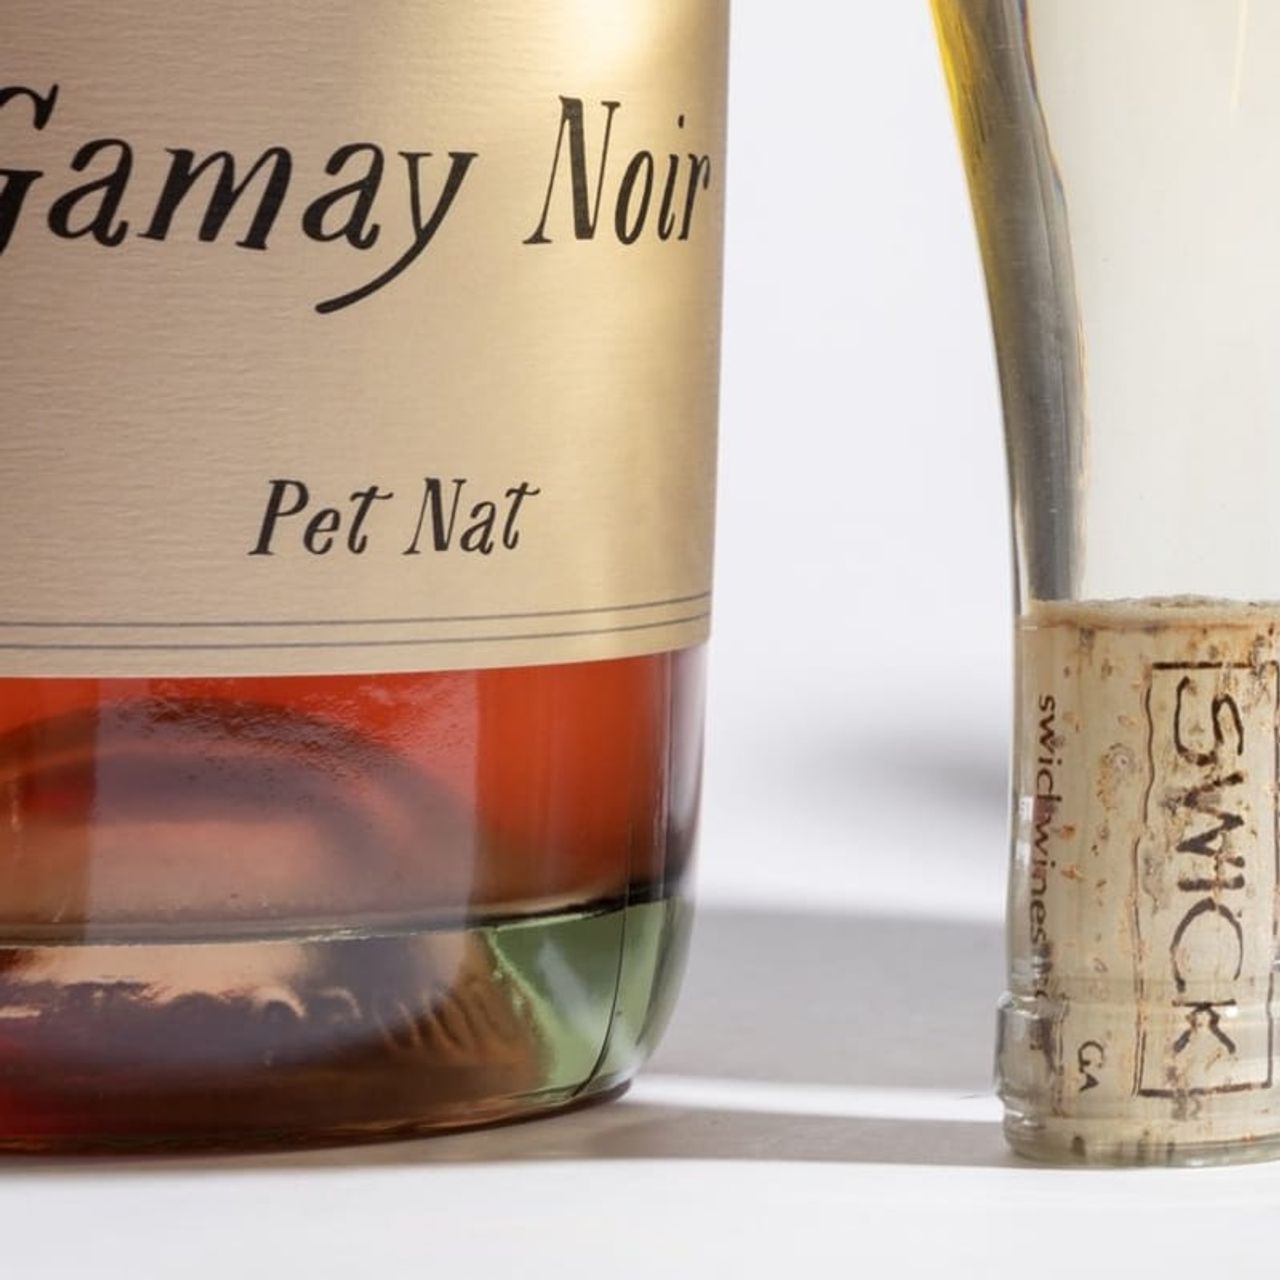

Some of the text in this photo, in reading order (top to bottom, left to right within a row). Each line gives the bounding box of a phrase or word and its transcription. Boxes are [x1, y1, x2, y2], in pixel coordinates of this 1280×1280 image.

[522, 96, 711, 245] Noir
[248, 476, 541, 555] Pet Nat
[1170, 675, 1246, 1054] SWICK
